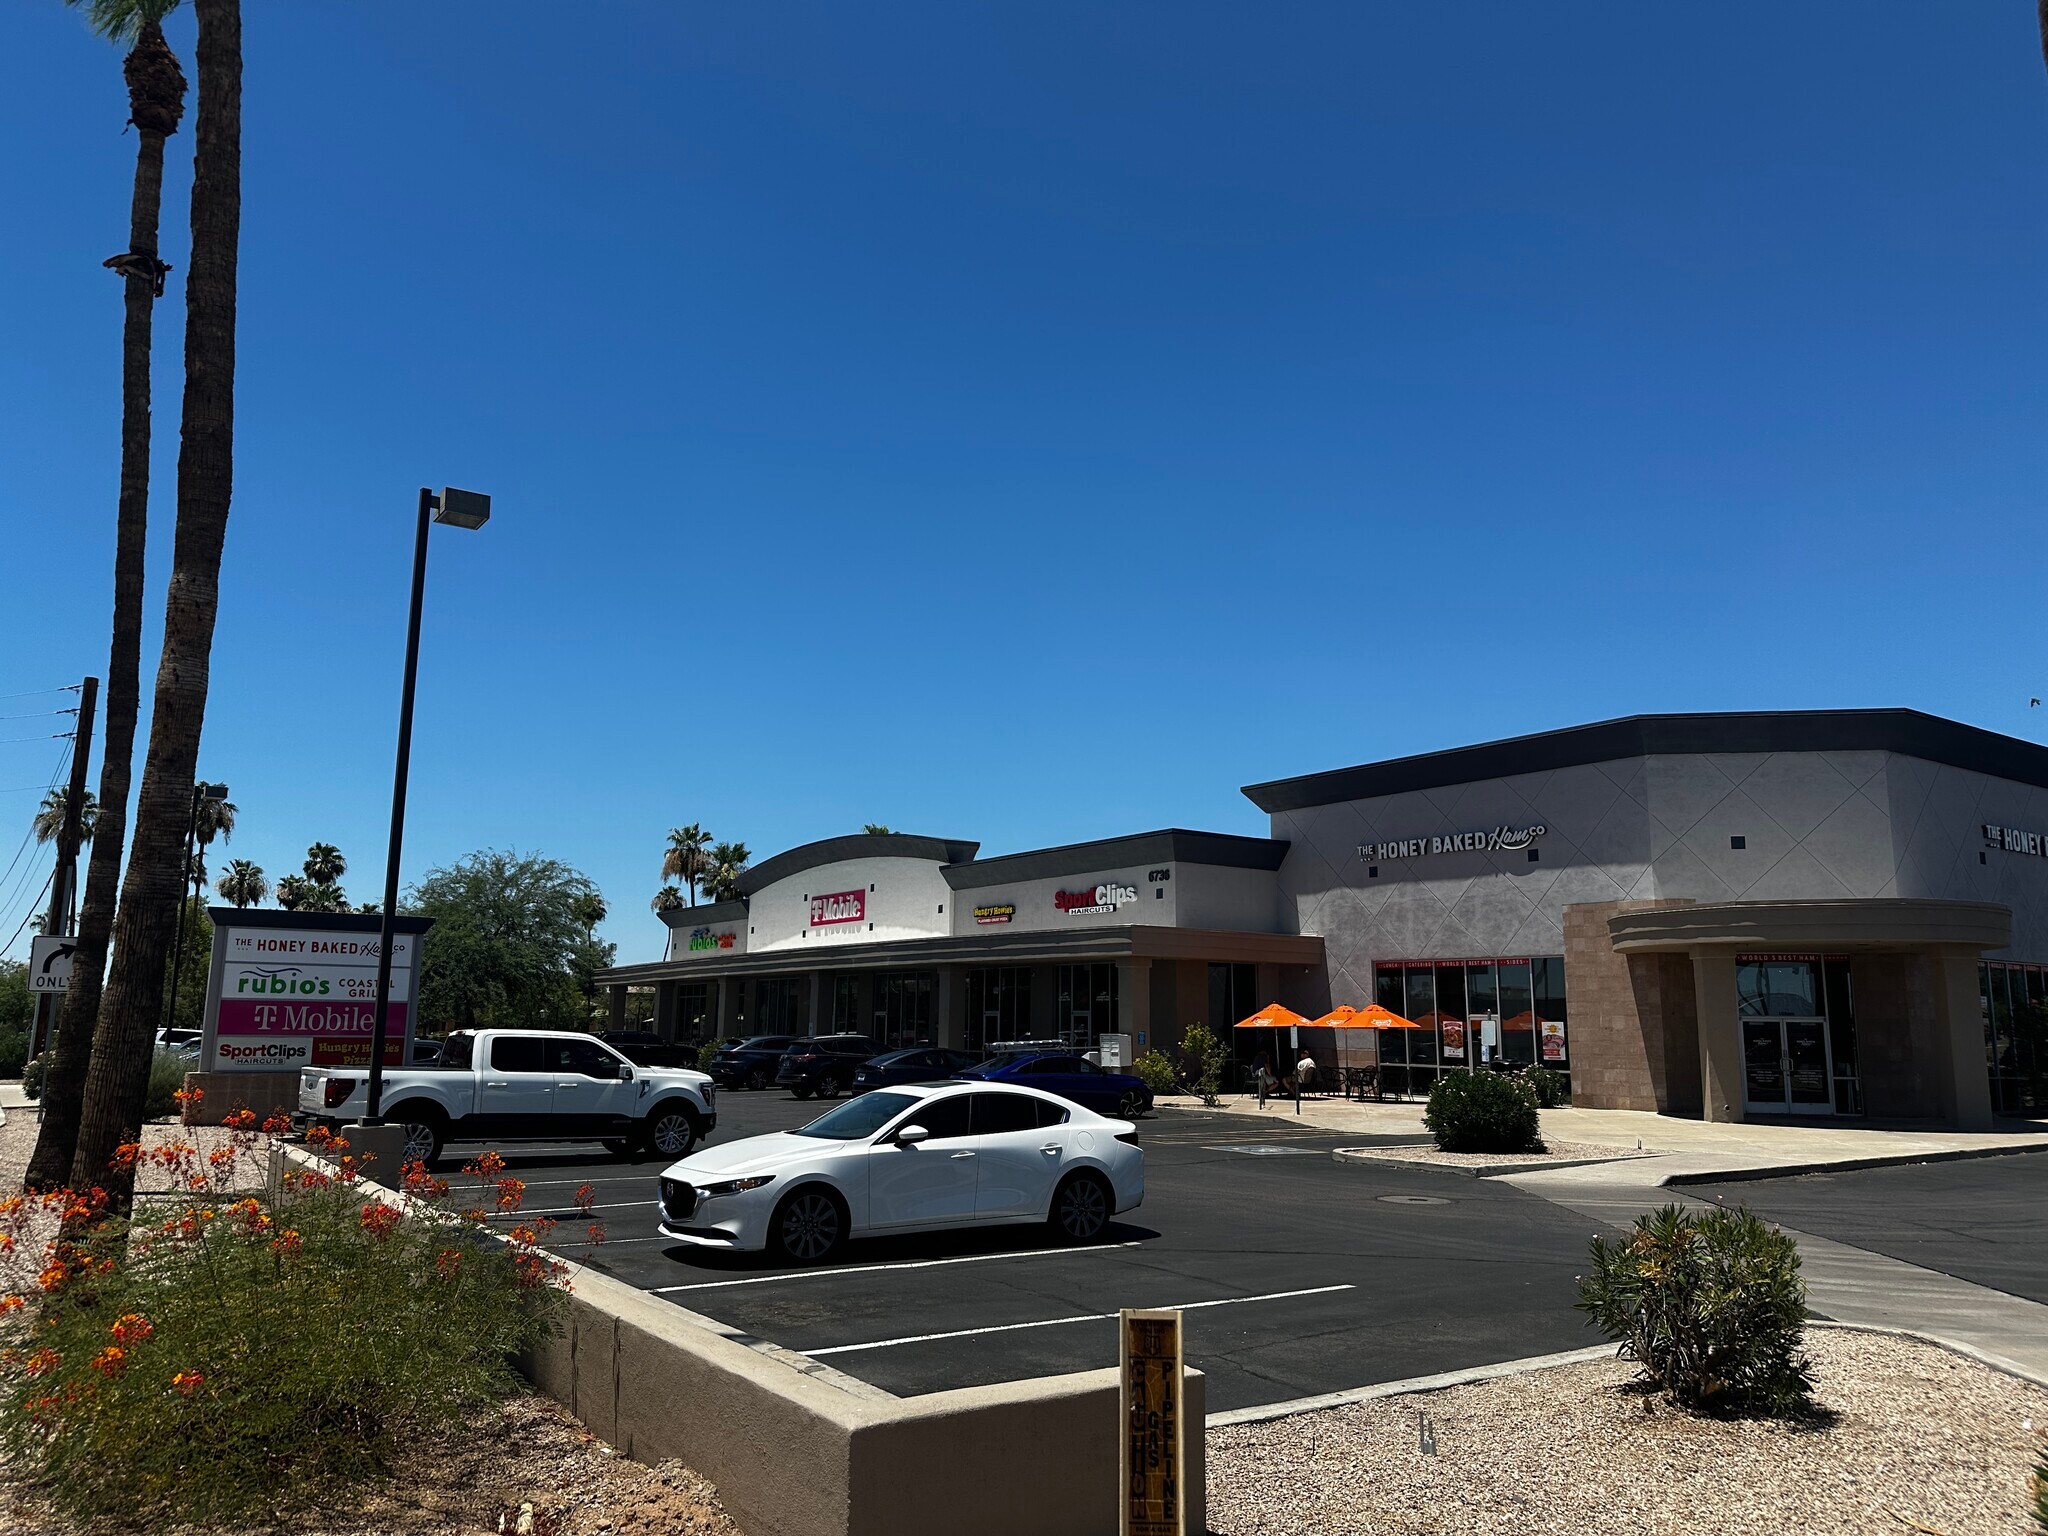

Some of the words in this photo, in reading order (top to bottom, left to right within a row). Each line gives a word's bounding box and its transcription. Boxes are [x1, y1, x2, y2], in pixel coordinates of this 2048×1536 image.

[1357, 844, 1373, 857] THE
[1378, 838, 1427, 860] HONEY
[1432, 832, 1486, 854] BAKED
[1488, 825, 1533, 851] Ham
[1529, 825, 1545, 836] CO
[1985, 825, 2001, 840] THE
[2003, 828, 2041, 856] HONEY
[1148, 869, 1170, 882] 6736
[822, 895, 861, 921] Mobile
[1054, 884, 1138, 913] SportClips
[1071, 905, 1110, 915] HAIRCUTS
[235, 938, 252, 946] THE
[257, 939, 306, 952] HONEY
[311, 941, 358, 954] BAKED
[238, 972, 330, 995] rubio's
[339, 978, 395, 989] COASTL
[349, 989, 378, 998] GRIL
[284, 1006, 375, 1031] Mobile
[219, 1044, 306, 1060] SportClips
[318, 1043, 360, 1053] Hungry
[1148, 1411, 1159, 1467] GAS
[1162, 1361, 1174, 1519] PIPELINE
